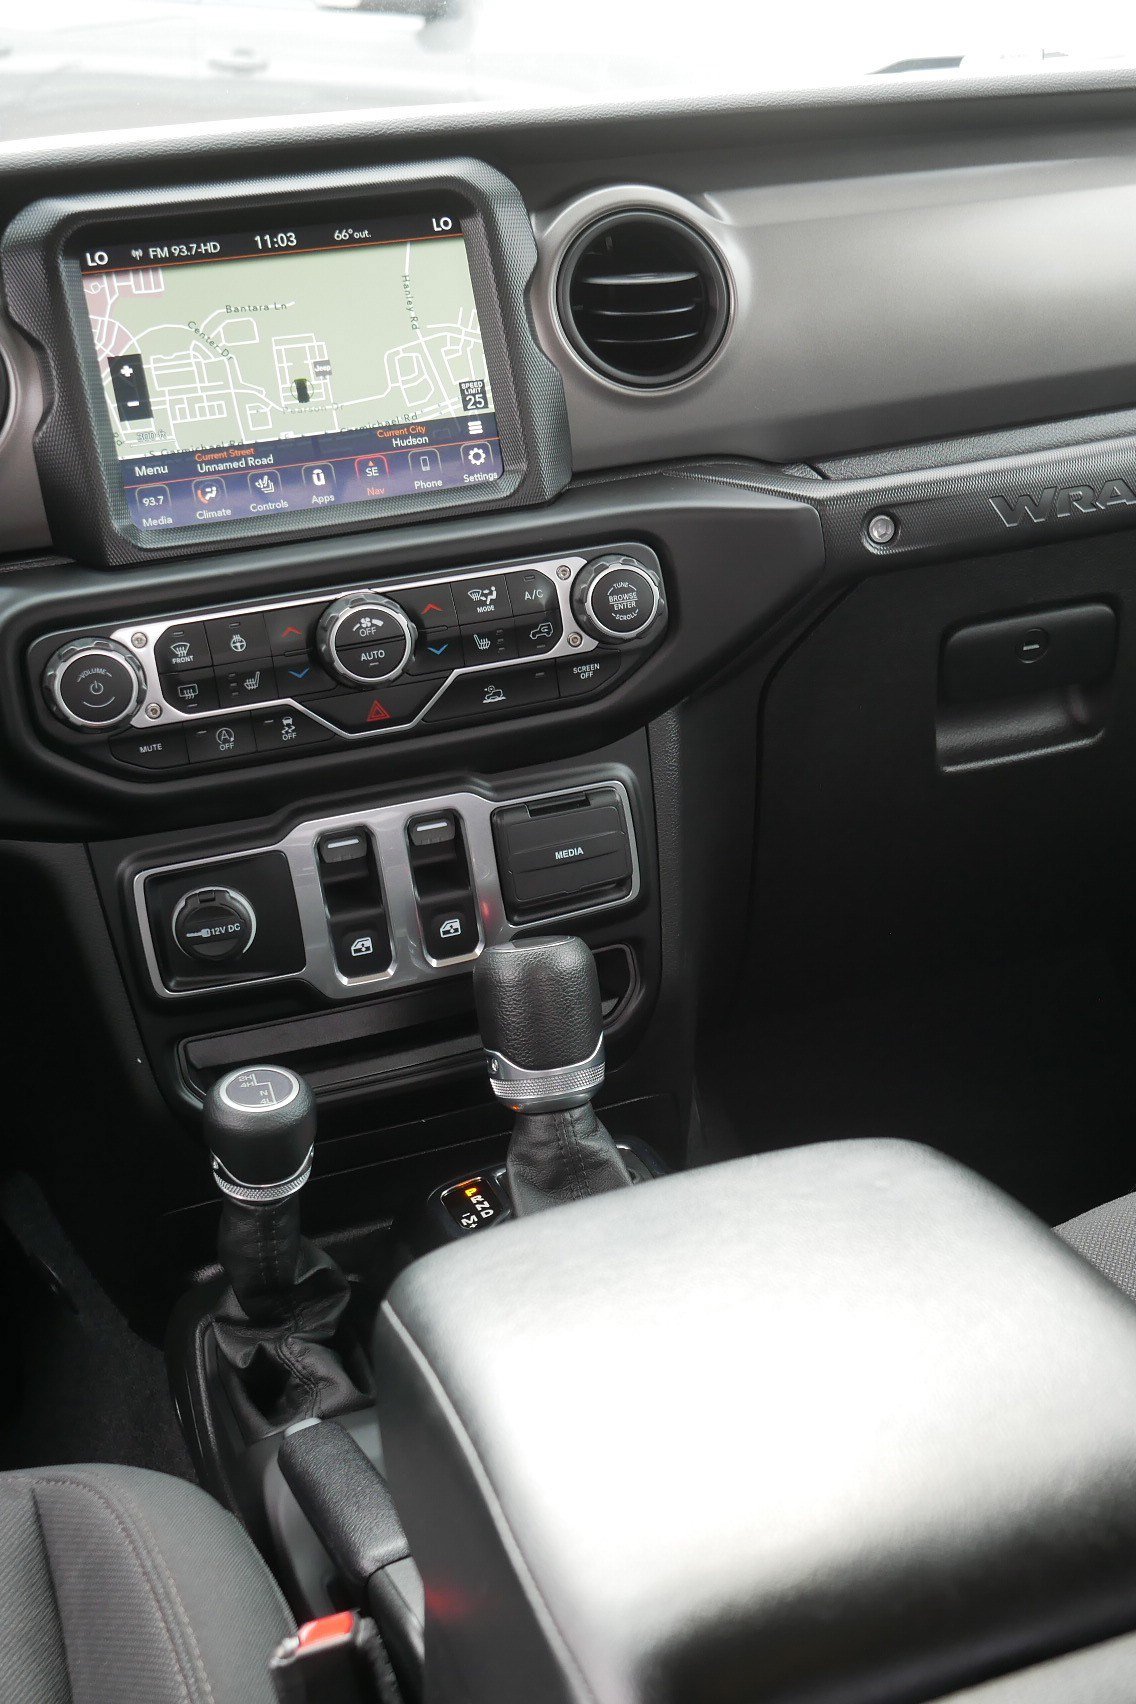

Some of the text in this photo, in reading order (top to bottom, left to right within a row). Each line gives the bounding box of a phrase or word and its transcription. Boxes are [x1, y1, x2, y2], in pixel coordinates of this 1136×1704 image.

[432, 216, 453, 232] LO
[254, 232, 298, 250] 11:03
[149, 241, 221, 259] FM 93.7-HD
[86, 251, 109, 267] LO
[188, 321, 233, 361] Center Dr
[461, 381, 483, 390] SPEED
[465, 387, 481, 395] LIMIT
[466, 394, 485, 410] 25
[377, 423, 427, 438] Current City
[392, 435, 429, 448] Hudson
[195, 447, 255, 462] Current Street
[197, 454, 274, 473] Unnamed Road
[135, 464, 169, 477] Menu
[366, 467, 379, 477] SE
[463, 472, 498, 483] Settings
[414, 479, 443, 490] Phone
[367, 487, 385, 496] Nav
[142, 496, 164, 507] 93.7
[311, 494, 335, 505] Apps
[250, 499, 289, 513] Controls
[196, 508, 232, 520] Climate
[142, 516, 173, 528] Media
[524, 588, 544, 601] A/C
[608, 592, 638, 602] BROWSE
[477, 604, 496, 614] MODE
[613, 601, 636, 611] ENTER
[615, 612, 637, 620] SCROLL
[359, 626, 377, 638] OFF
[172, 655, 194, 664] FRONT
[360, 649, 386, 662] AUTO
[573, 663, 600, 674] SCREEN
[580, 670, 595, 680] OFF
[282, 732, 297, 741] OFF
[140, 743, 163, 753] MUTE
[219, 742, 235, 751] OFF
[555, 846, 585, 861] MEDIA
[211, 923, 241, 936] 12V DC
[470, 1195, 484, 1204] R
[475, 1200, 490, 1211] N
[480, 1209, 494, 1218] D
